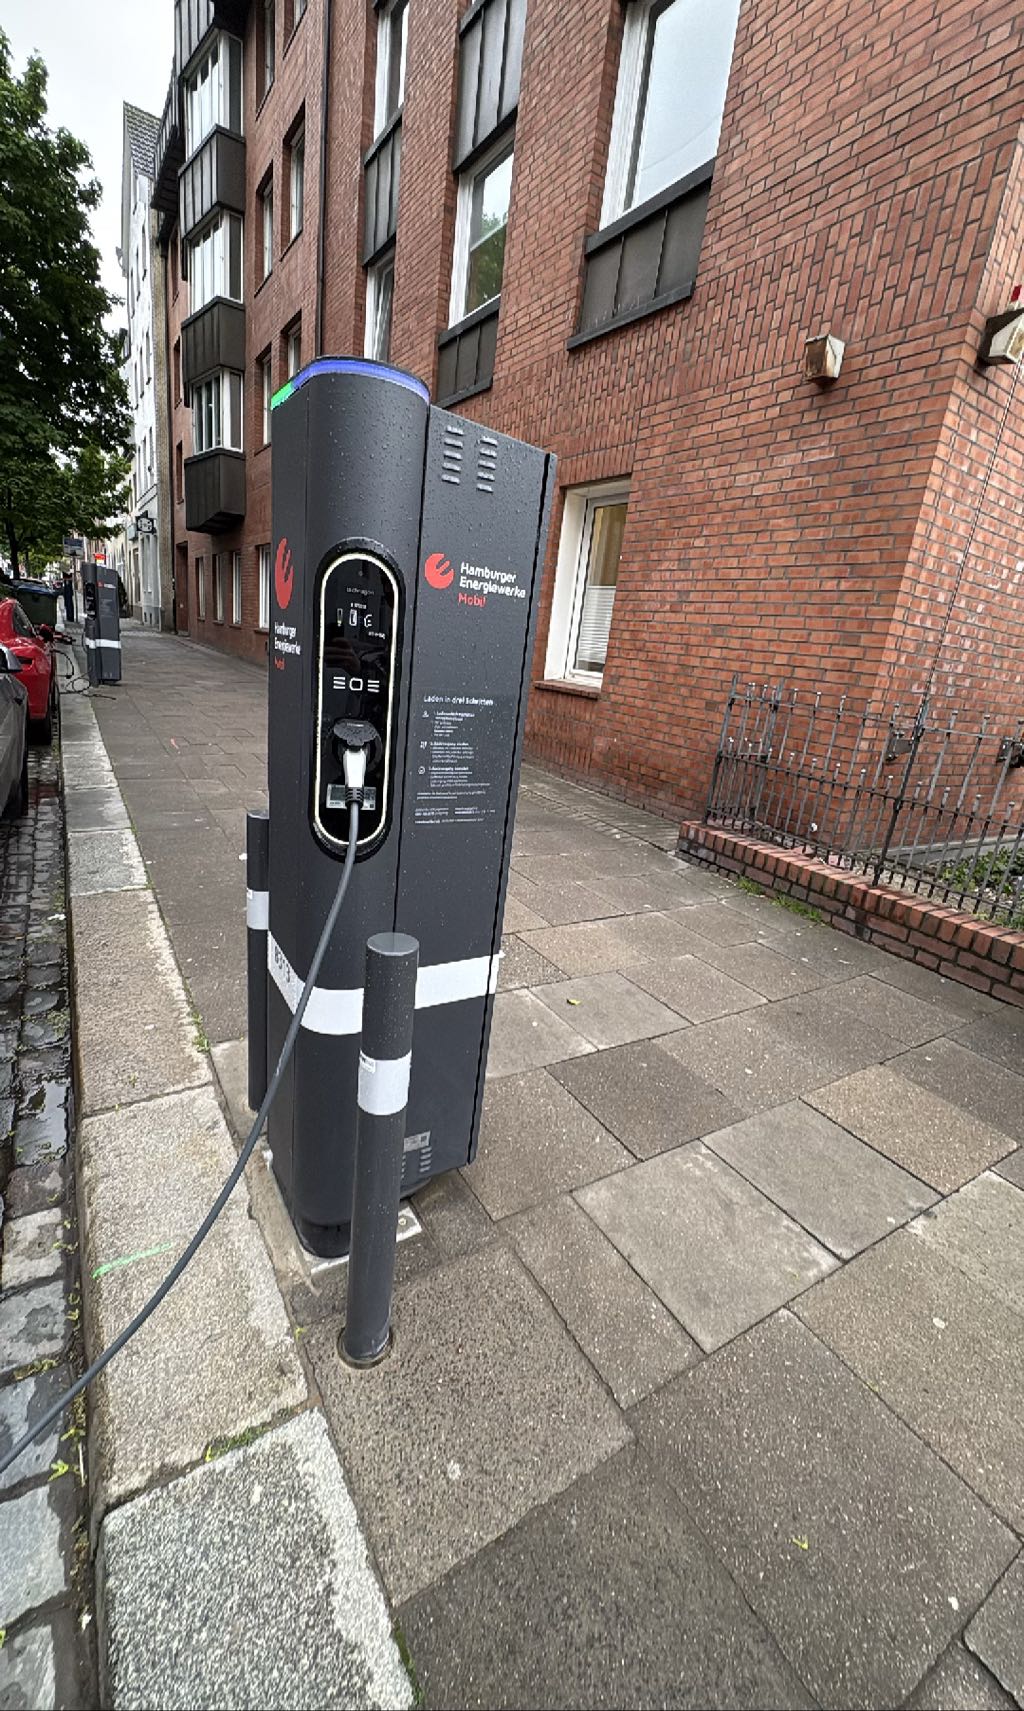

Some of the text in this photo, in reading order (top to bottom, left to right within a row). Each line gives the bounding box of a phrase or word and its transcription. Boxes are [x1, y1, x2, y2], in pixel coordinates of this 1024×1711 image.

[460, 562, 516, 583] Hamburger
[459, 576, 526, 598] Energiewerke
[458, 593, 487, 607] Mobil
[451, 696, 465, 704] drei
